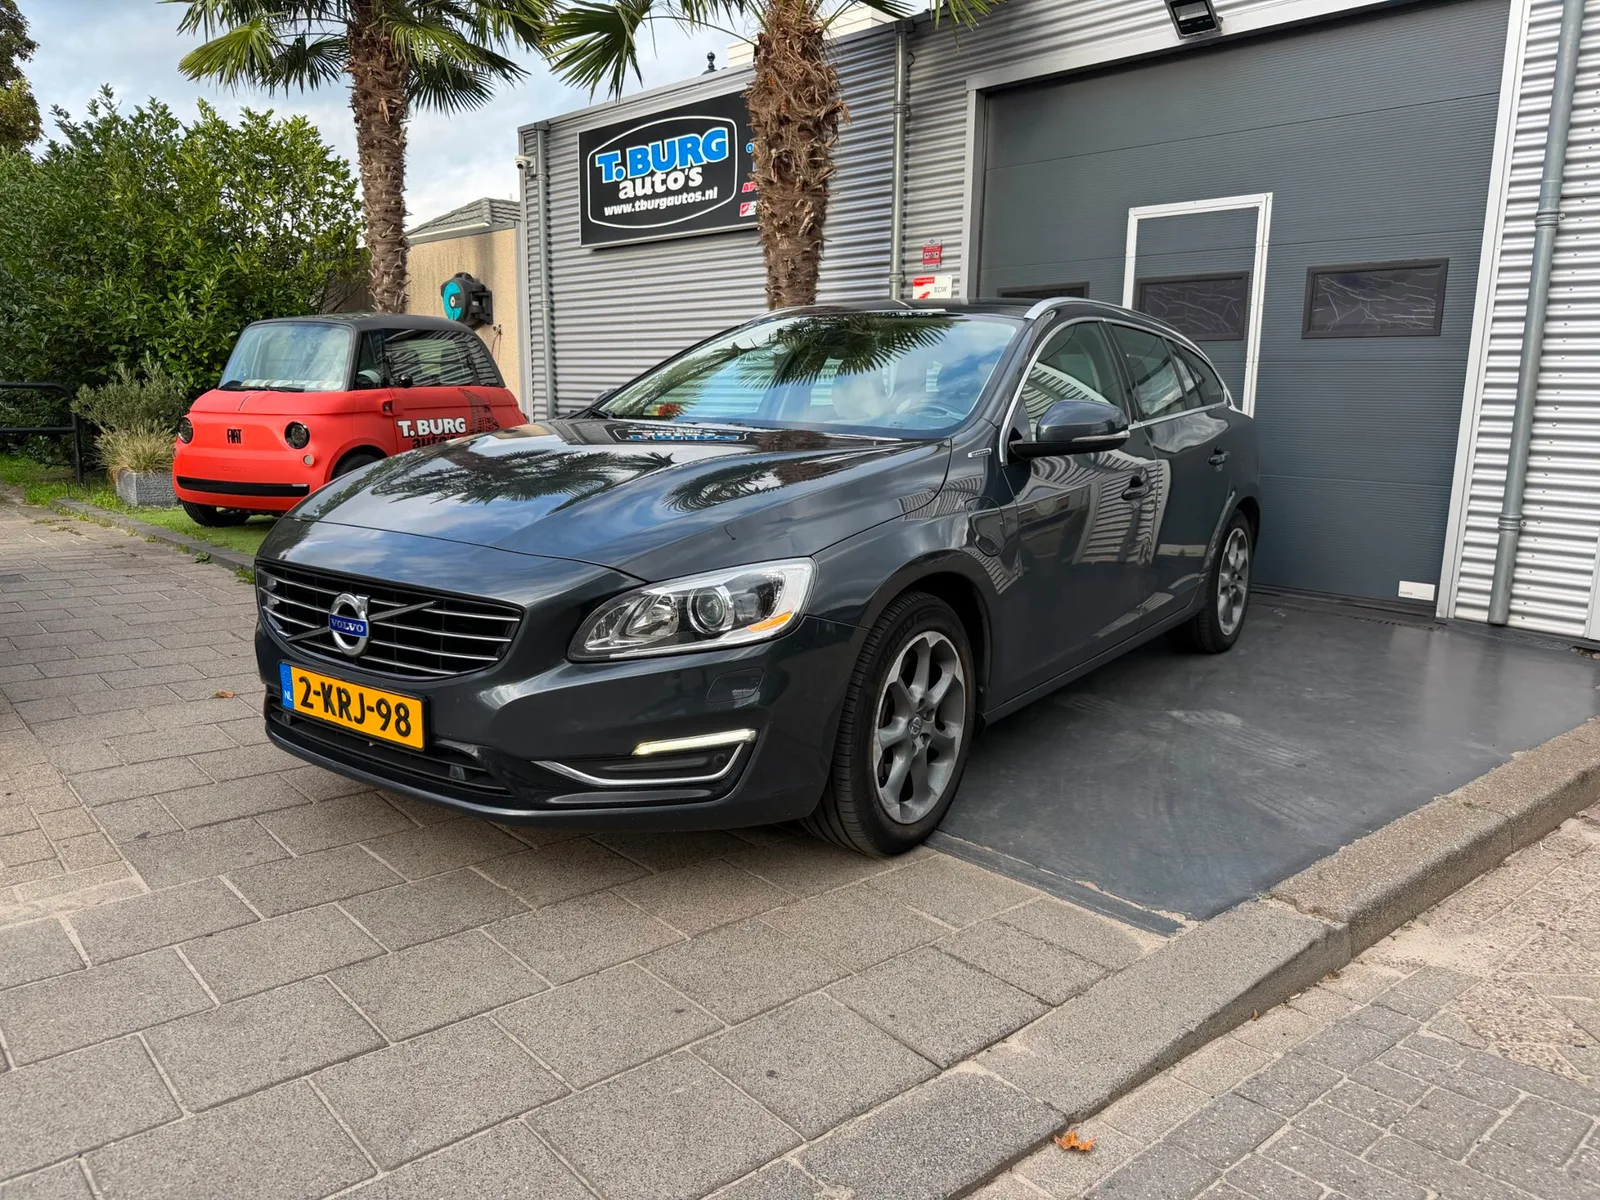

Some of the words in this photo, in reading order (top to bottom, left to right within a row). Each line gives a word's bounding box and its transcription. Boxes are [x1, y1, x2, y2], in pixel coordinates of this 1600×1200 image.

[595, 127, 729, 183] T.BURG
[618, 167, 703, 199] auto's
[604, 186, 718, 216] www.tburgautos.nl
[227, 428, 242, 444] FIAT
[331, 618, 364, 633] VOLVO
[284, 690, 293, 701] NL
[299, 676, 411, 738] 2-KRJ-98
